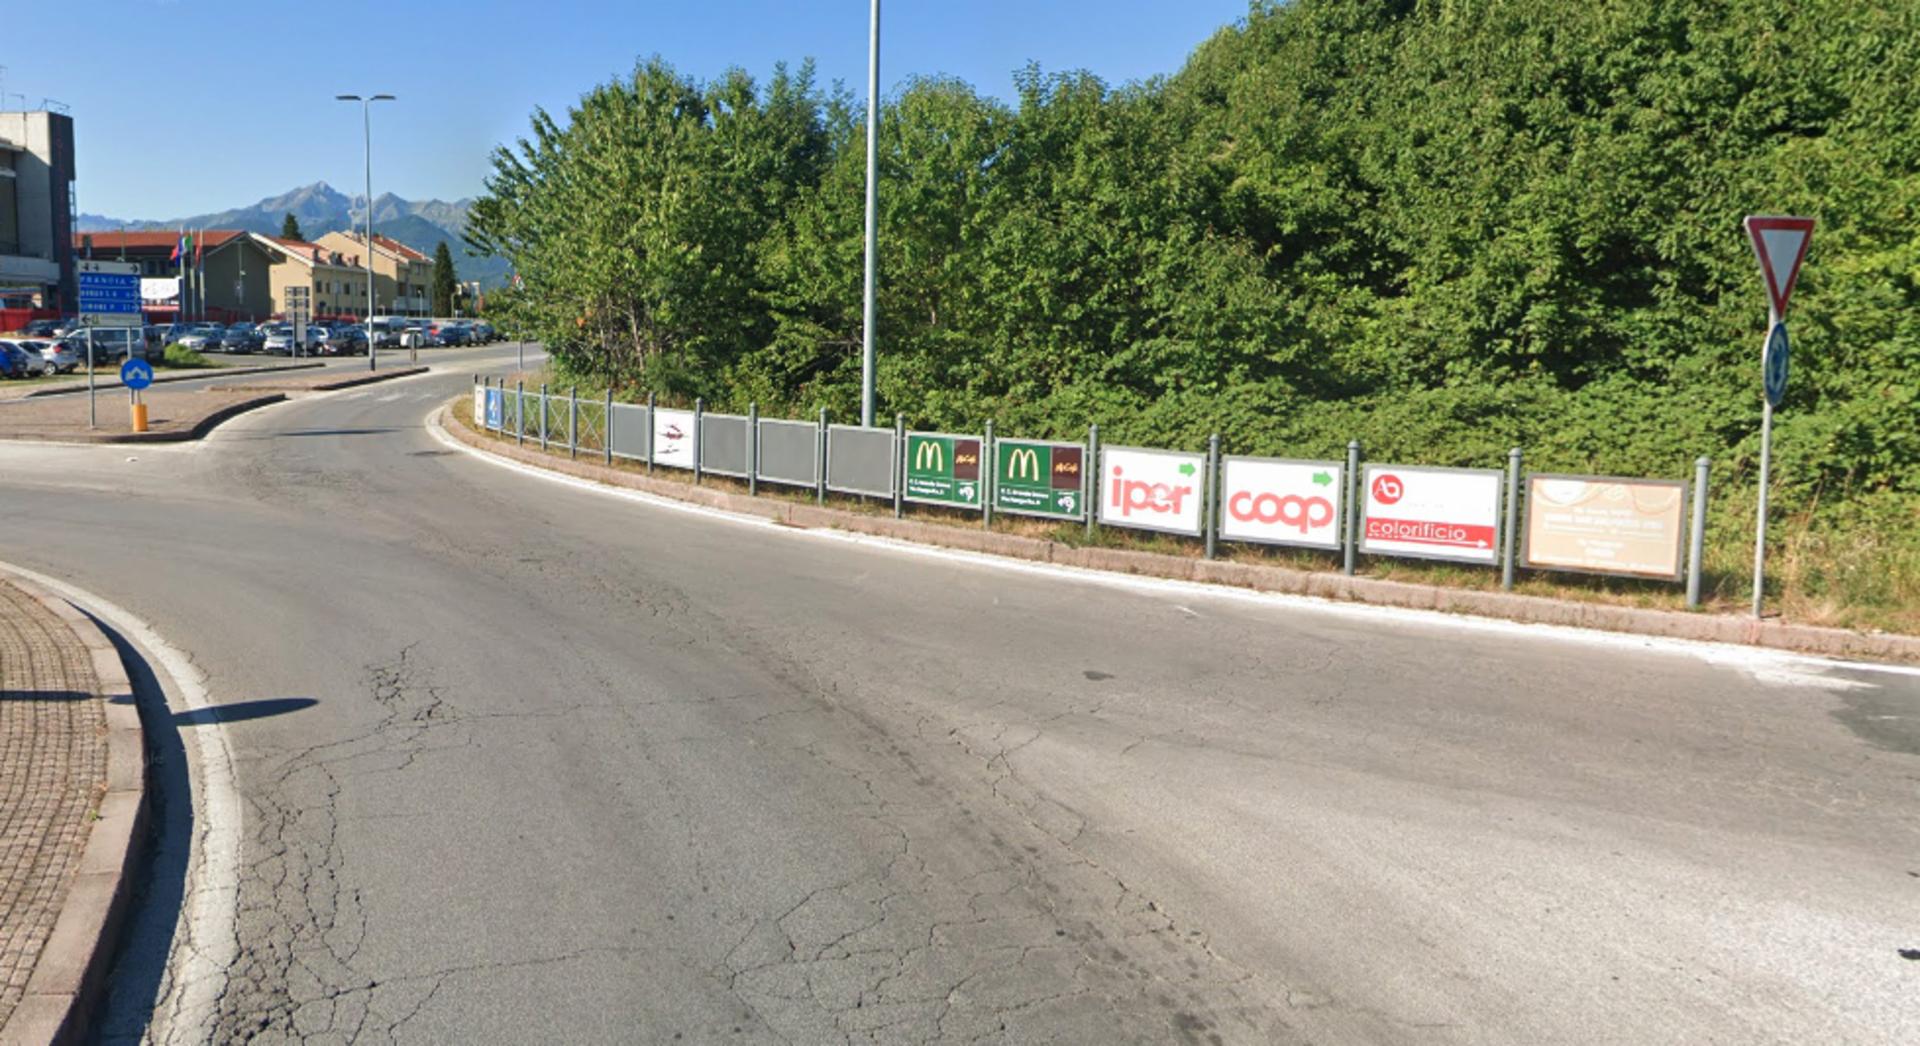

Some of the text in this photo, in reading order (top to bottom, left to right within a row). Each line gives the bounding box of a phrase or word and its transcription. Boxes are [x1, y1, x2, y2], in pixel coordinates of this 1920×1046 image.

[1112, 465, 1192, 516] iper
[1228, 490, 1334, 534] coop
[1368, 520, 1467, 541] colorificio
